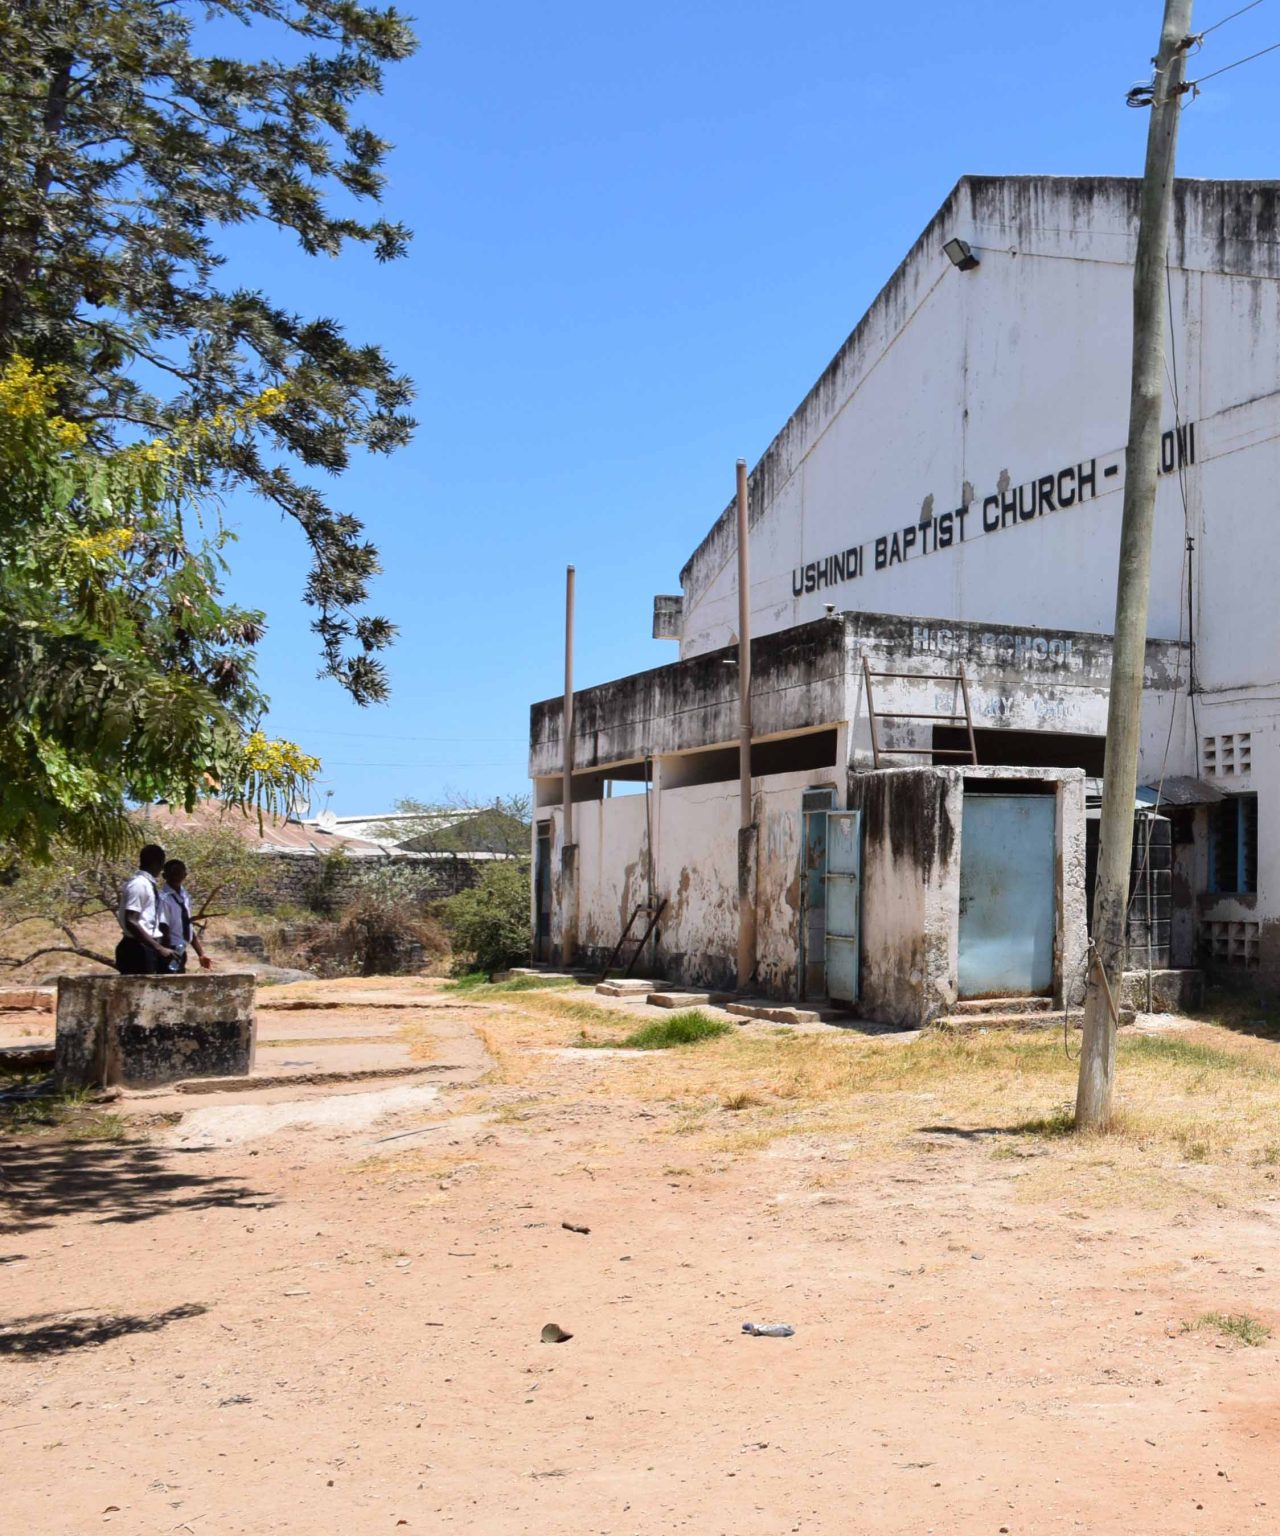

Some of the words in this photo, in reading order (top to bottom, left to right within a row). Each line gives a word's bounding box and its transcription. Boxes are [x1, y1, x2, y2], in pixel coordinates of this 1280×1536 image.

[792, 545, 863, 598] USHINDI
[875, 505, 968, 571] BAPTIST
[982, 458, 1096, 533] CHURCH
